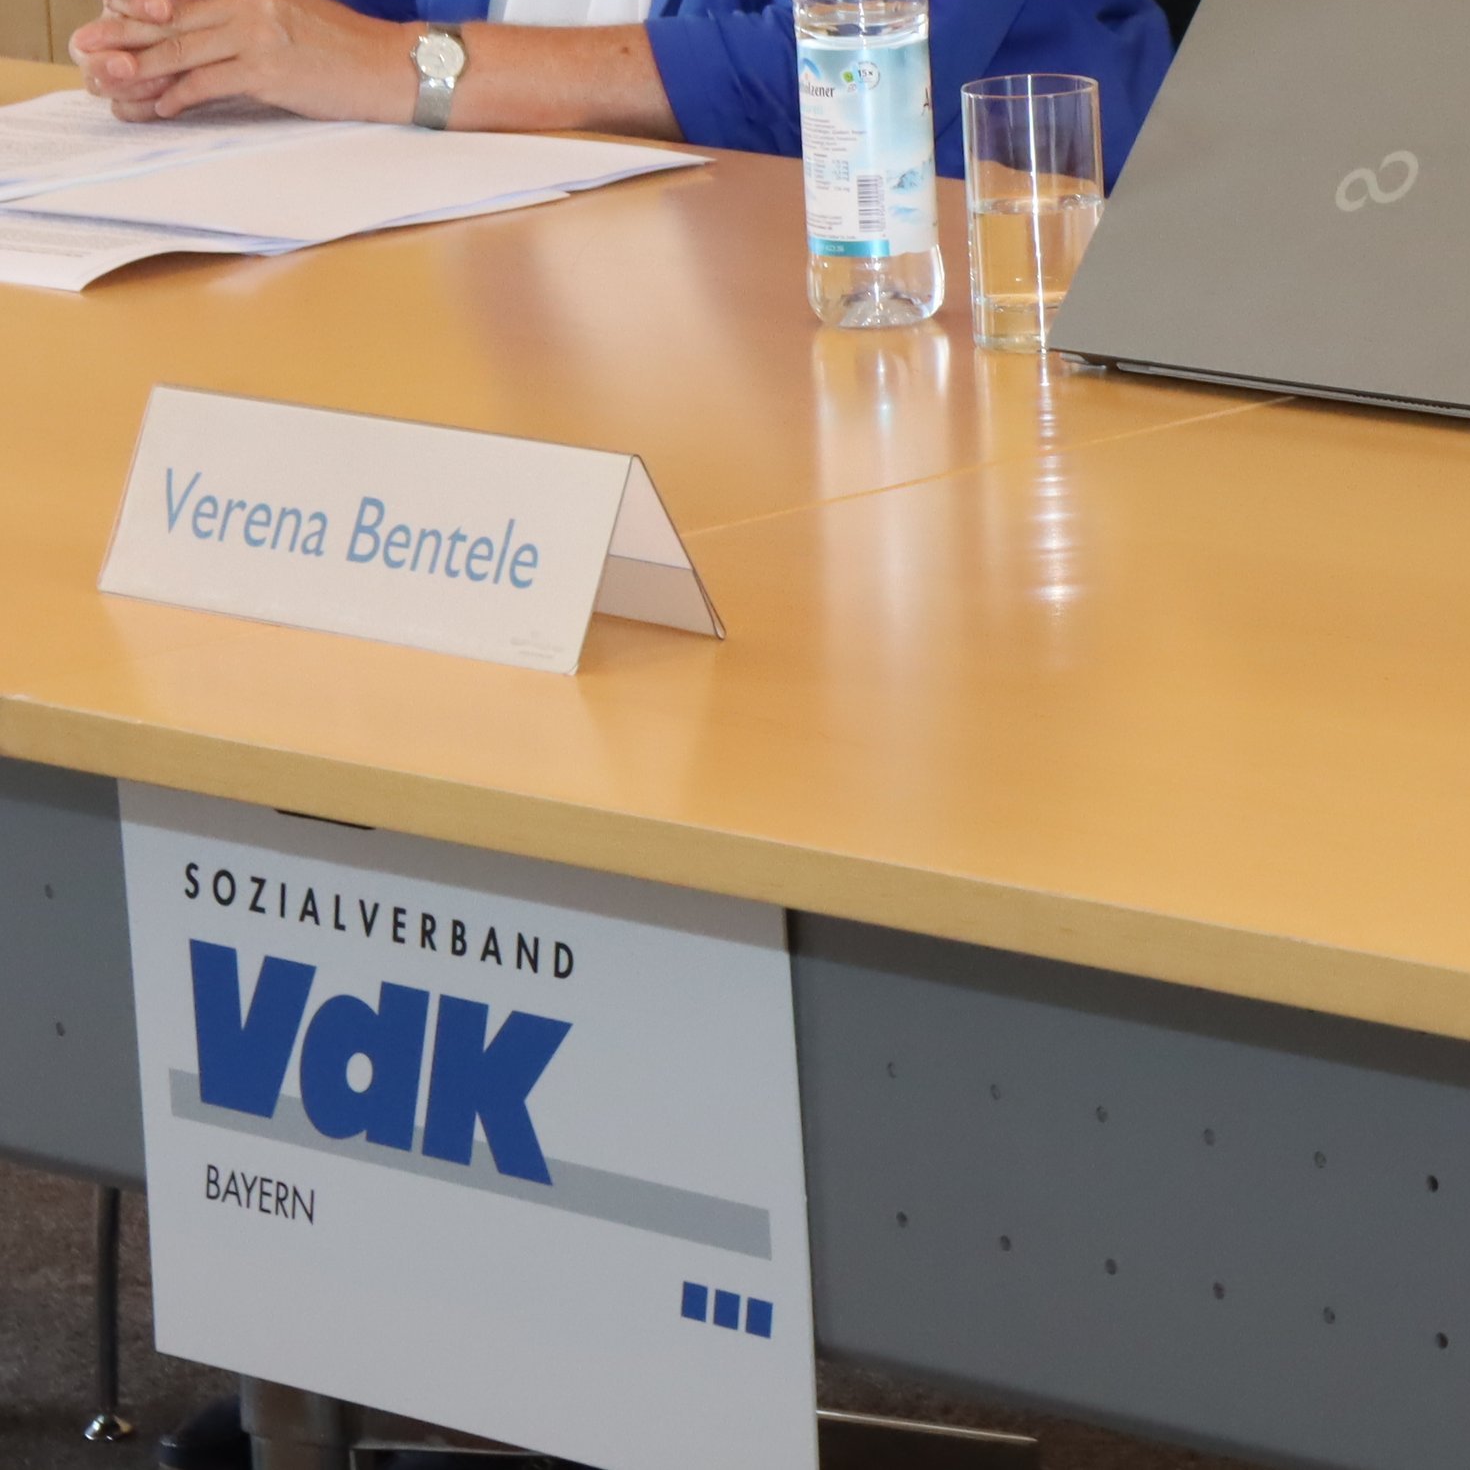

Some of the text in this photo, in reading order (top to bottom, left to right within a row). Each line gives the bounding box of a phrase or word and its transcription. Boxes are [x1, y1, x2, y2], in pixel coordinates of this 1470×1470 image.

[165, 468, 538, 589] Verena Bentele
[184, 862, 574, 979] SOZIALVERBAND
[189, 938, 572, 1187] VdK
[204, 1163, 316, 1226] BAYERN
